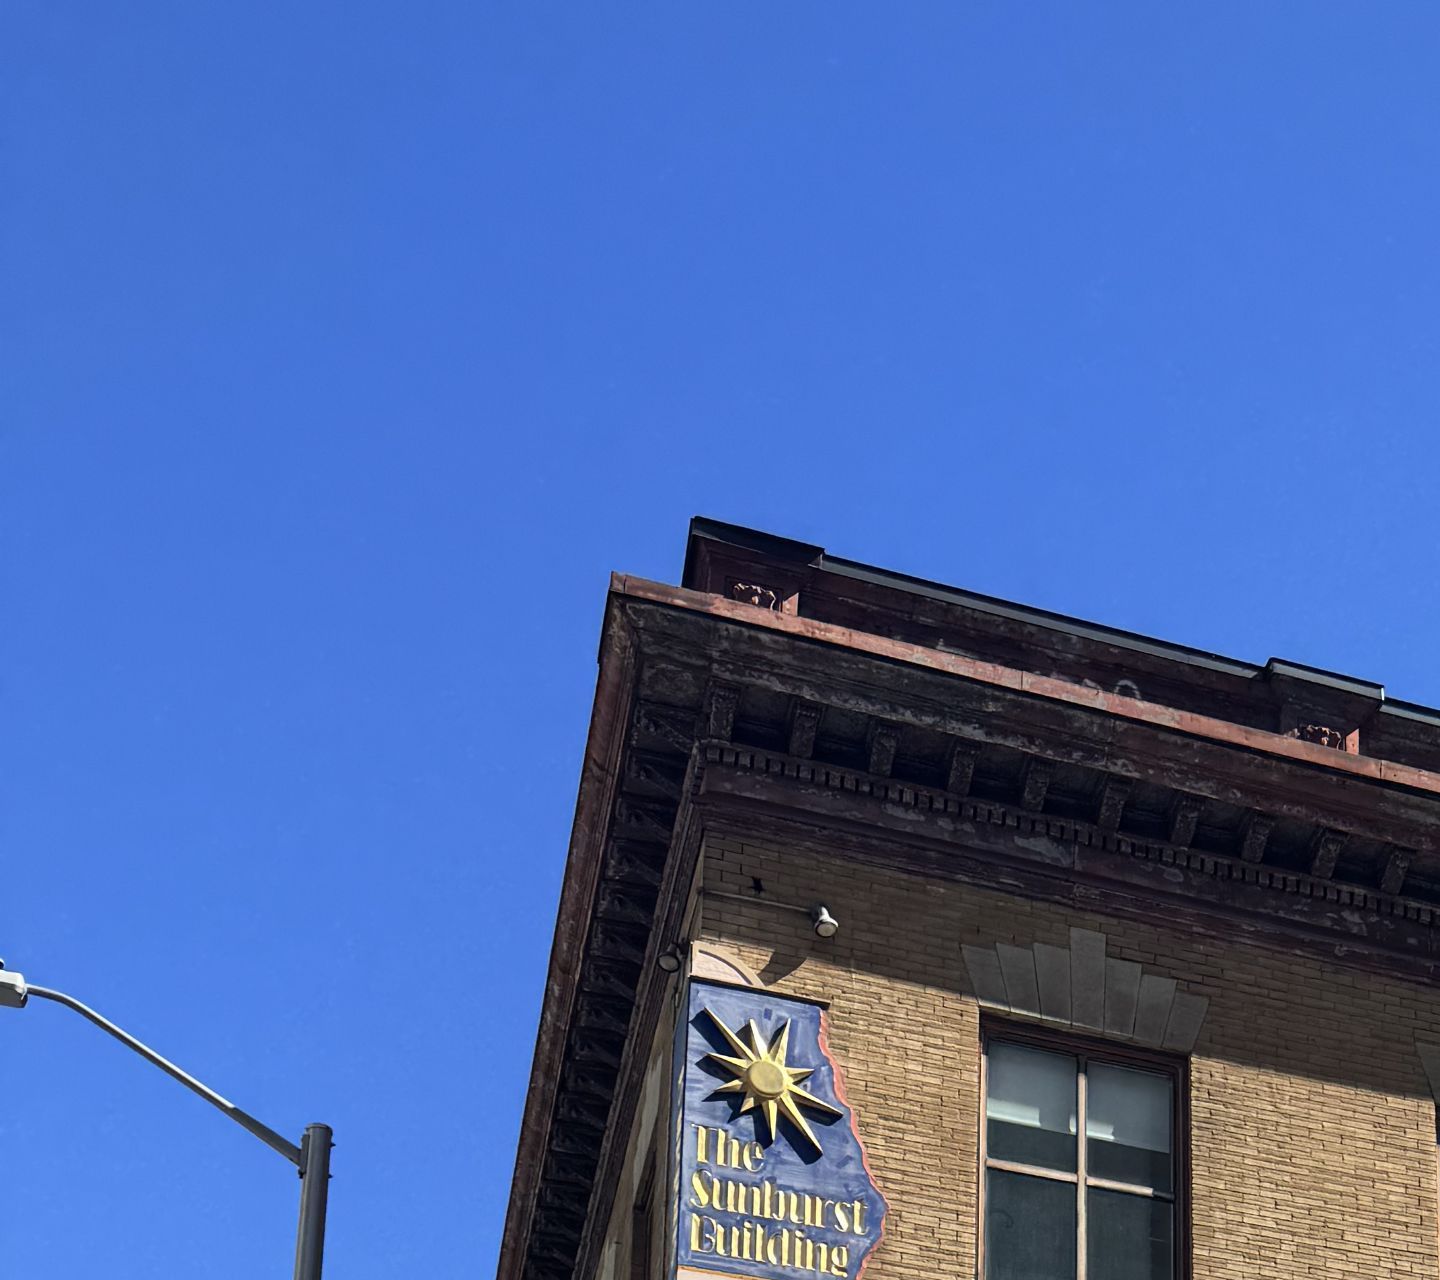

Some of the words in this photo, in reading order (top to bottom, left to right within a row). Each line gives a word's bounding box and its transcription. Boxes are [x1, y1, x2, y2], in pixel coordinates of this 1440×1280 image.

[692, 1124, 766, 1172] The
[690, 1169, 868, 1236] Sunburst
[690, 1213, 850, 1278] Building
